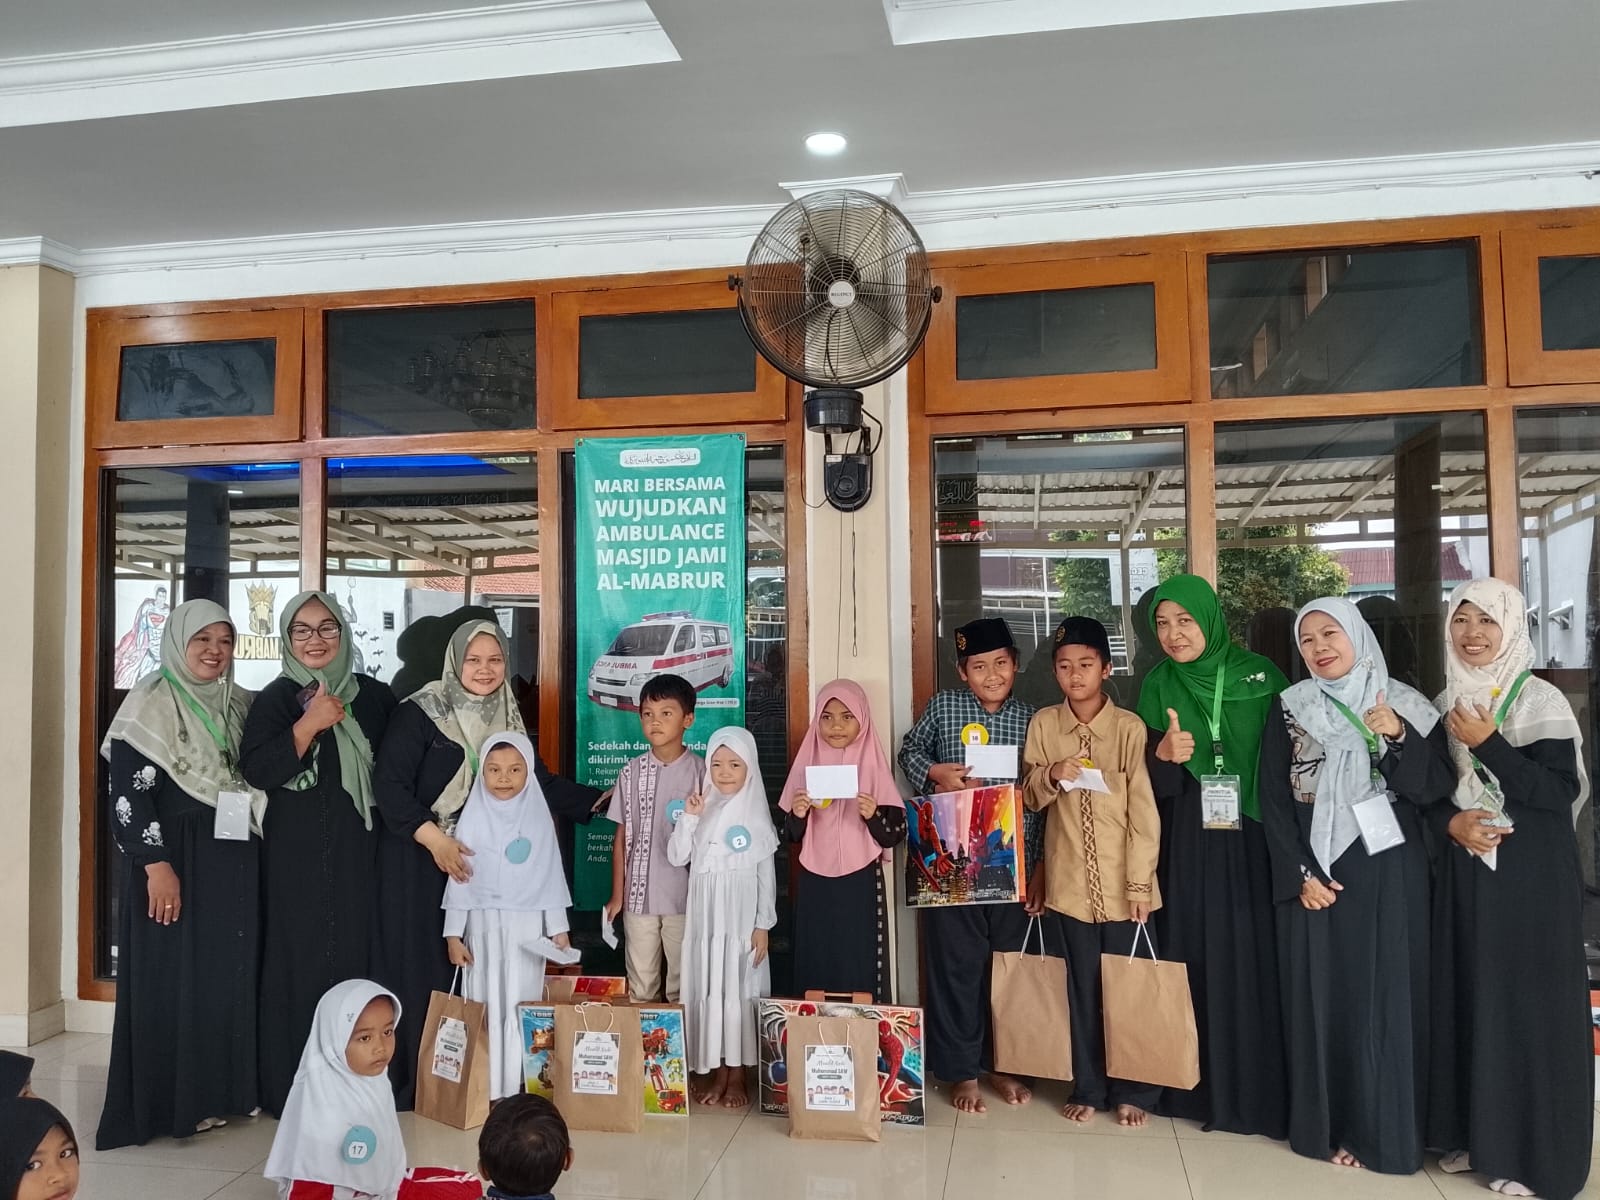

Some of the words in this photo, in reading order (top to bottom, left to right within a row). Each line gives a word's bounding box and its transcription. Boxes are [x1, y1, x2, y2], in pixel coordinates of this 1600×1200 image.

[594, 479, 639, 493] MARI
[644, 477, 726, 492] BERSAMA
[595, 497, 726, 521] WUJUDKAN
[596, 523, 725, 542] AMBULANCE
[596, 548, 671, 569] MASJID
[675, 547, 727, 569] JAMI
[597, 572, 726, 591] AL-MABRUR
[588, 741, 631, 751] Sedekah
[632, 741, 651, 751] dan
[736, 838, 743, 846] 2
[352, 1145, 364, 1155] 17
